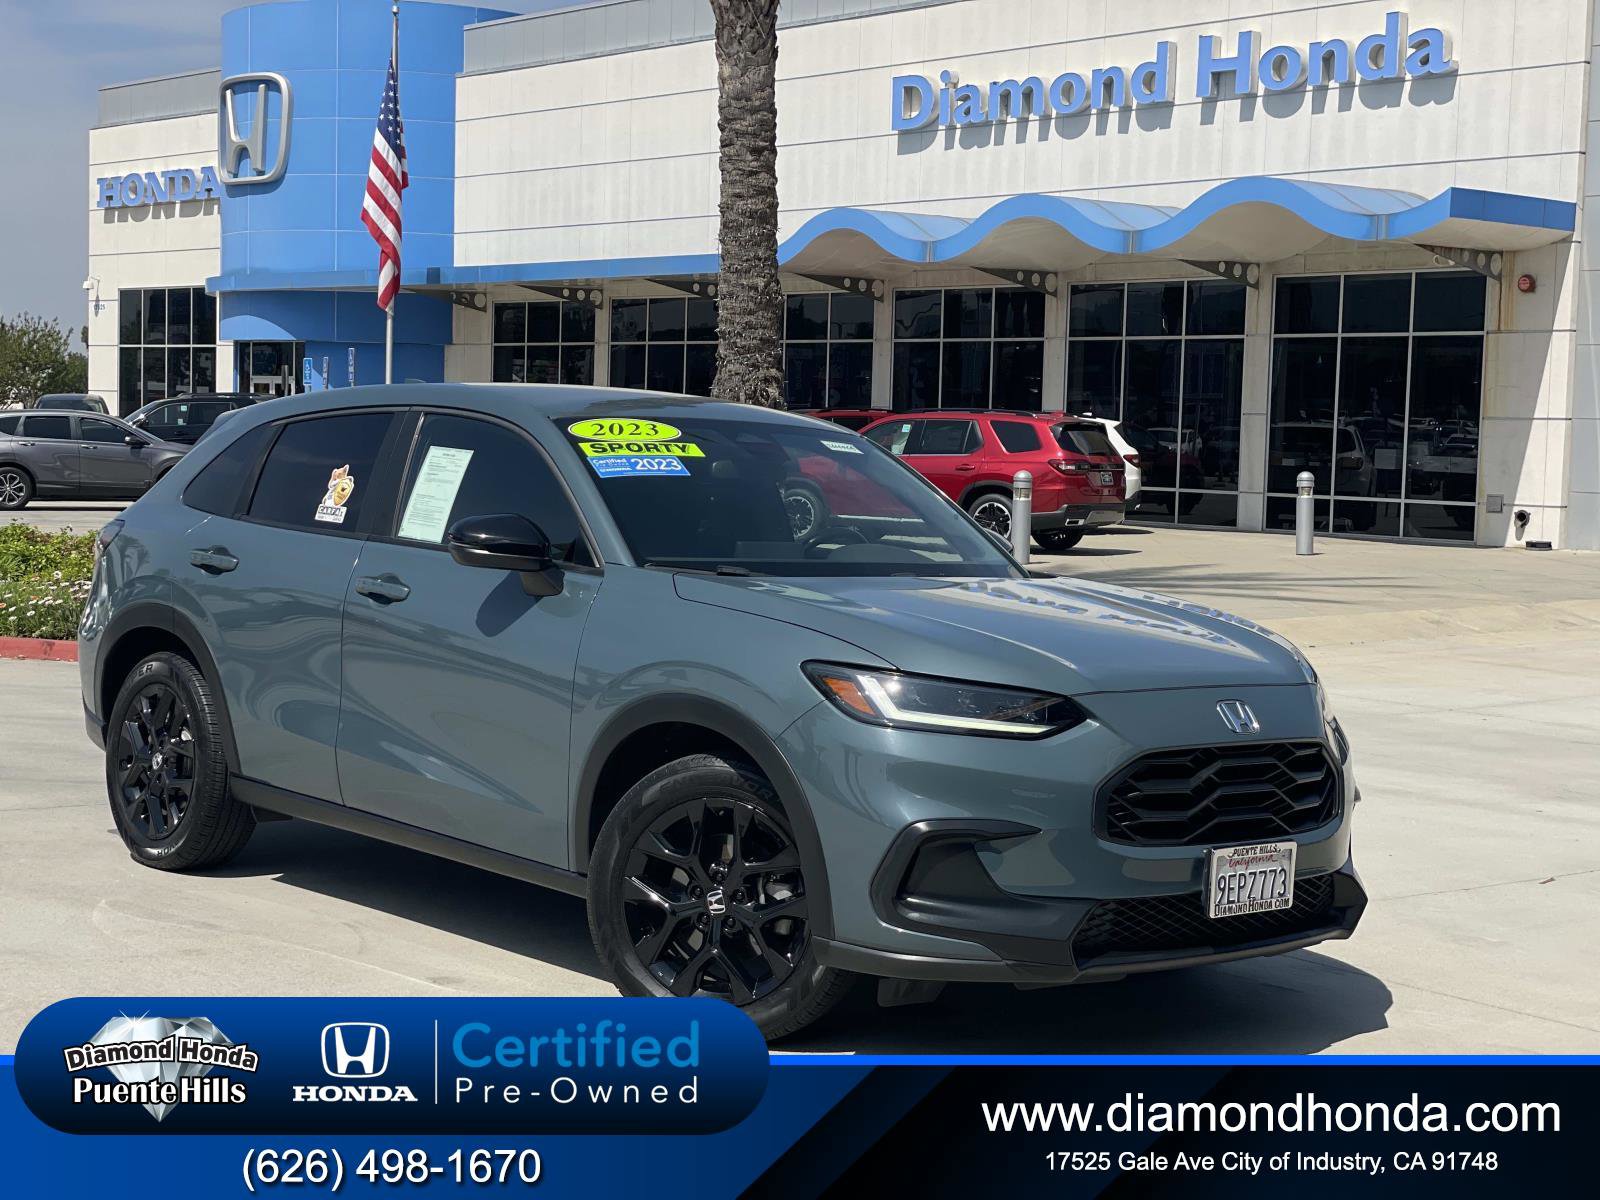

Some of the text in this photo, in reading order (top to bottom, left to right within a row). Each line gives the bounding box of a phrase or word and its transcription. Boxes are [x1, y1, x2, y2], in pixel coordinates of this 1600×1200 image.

[892, 11, 1459, 132] Diamond Honda
[96, 165, 221, 208] HONDA
[590, 423, 660, 436] 2023
[590, 443, 690, 453] SPORTY
[630, 458, 682, 470] 2023
[1231, 843, 1279, 858] PUENTE HILLS
[1217, 867, 1287, 904] 9EPZ773
